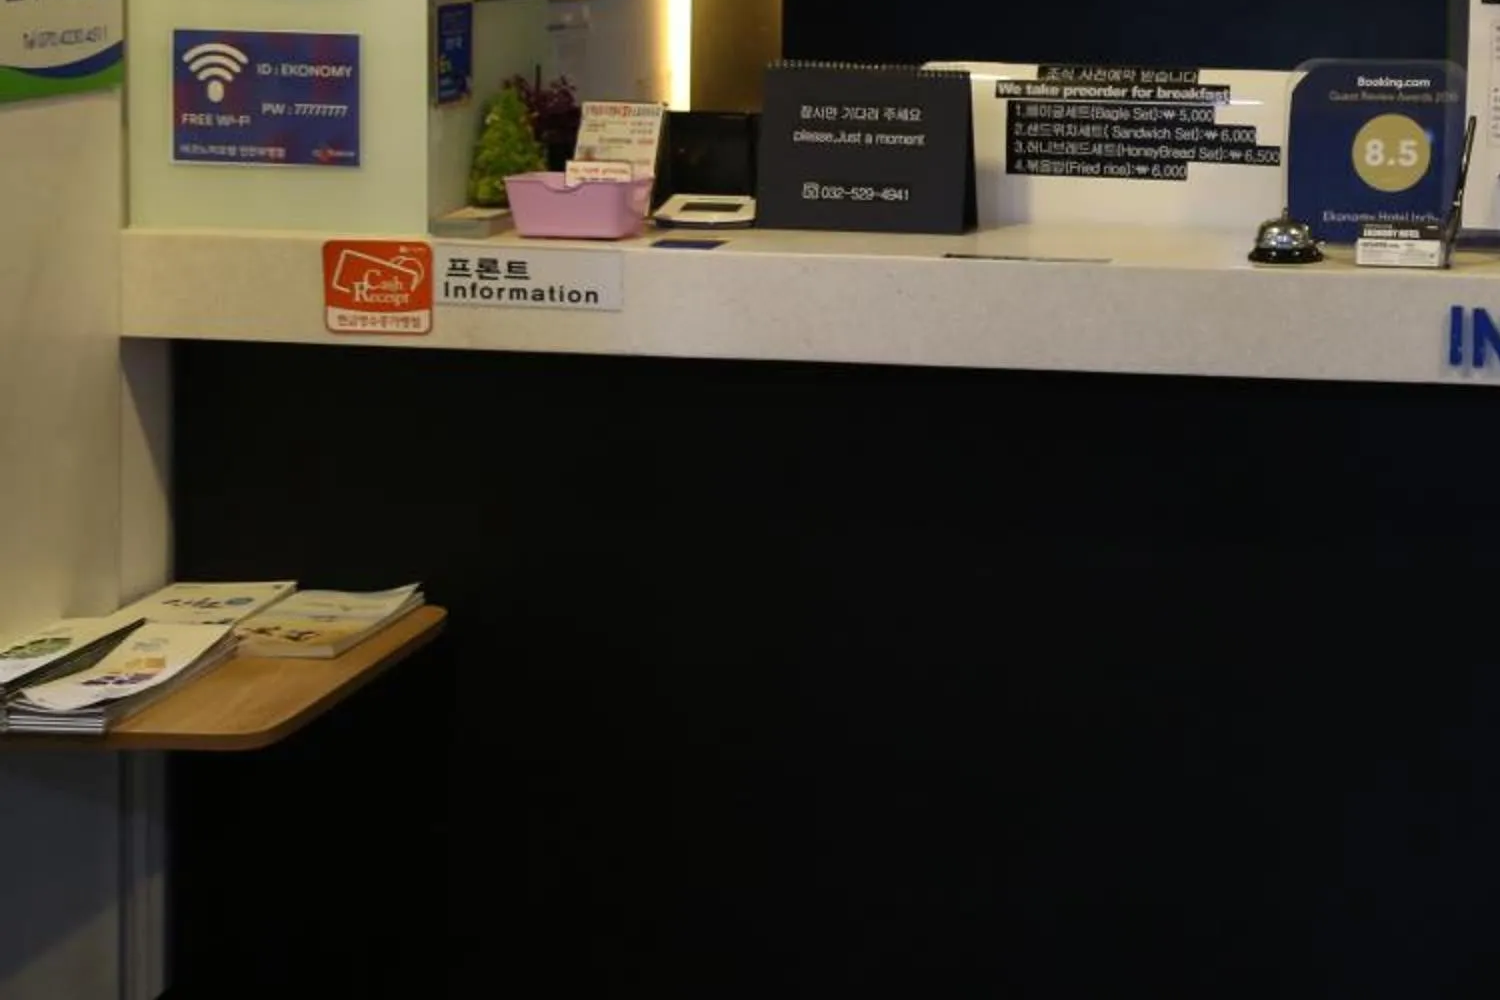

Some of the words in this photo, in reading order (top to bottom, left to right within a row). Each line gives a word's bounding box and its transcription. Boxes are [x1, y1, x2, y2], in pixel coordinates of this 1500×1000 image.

[257, 63, 273, 76] ID
[281, 63, 353, 78] EKONOMY
[1000, 82, 1022, 95] We
[1025, 83, 1060, 96] take
[1063, 86, 1128, 98] preorder
[1131, 85, 1155, 98] for
[1357, 75, 1431, 90] Booking.com
[261, 103, 287, 116] PW
[801, 105, 838, 121] 잠시만
[841, 106, 880, 122] 기다려
[883, 108, 923, 123] 주세요
[181, 112, 214, 127] FREE
[864, 133, 874, 145] a
[1364, 138, 1419, 168] 8.5
[447, 257, 531, 280] 프론트
[443, 281, 600, 305] Information
